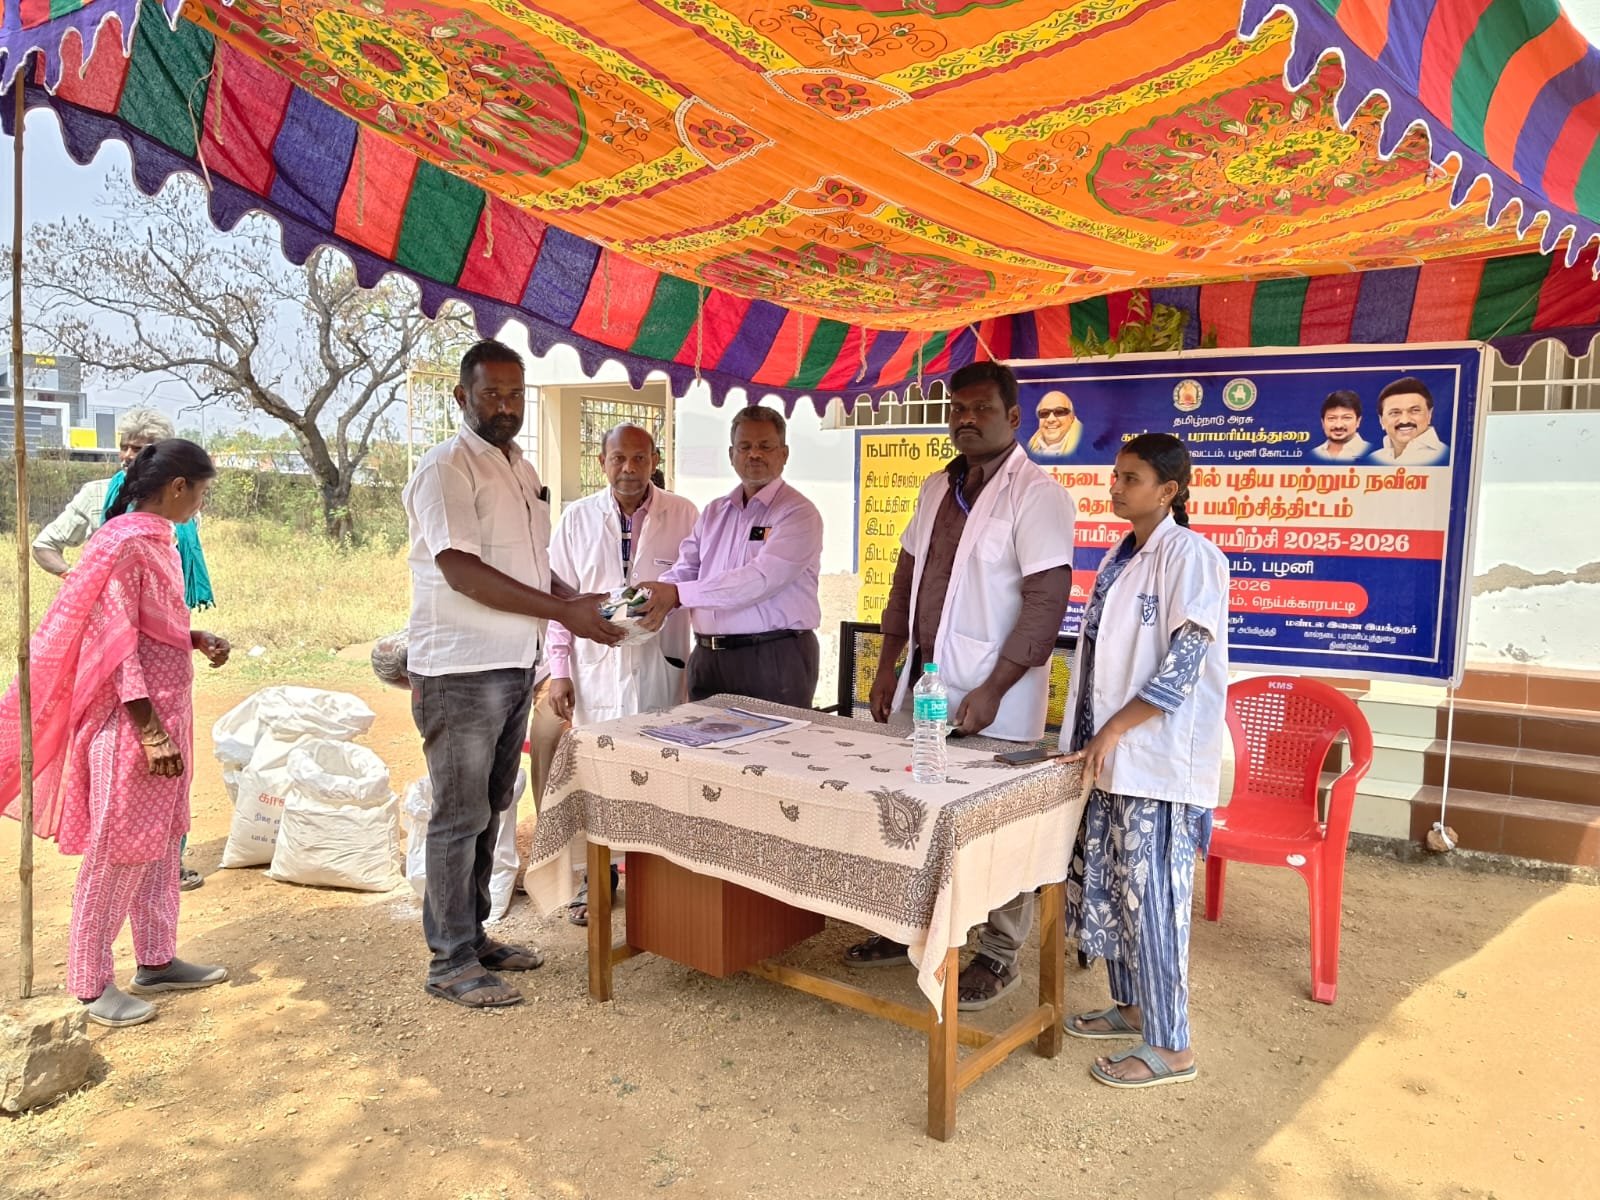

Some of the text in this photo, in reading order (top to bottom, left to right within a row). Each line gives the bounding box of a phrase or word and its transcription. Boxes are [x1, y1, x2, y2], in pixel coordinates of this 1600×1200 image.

[1173, 415, 1254, 427] தமிழ்நாடு அரசு
[1188, 428, 1310, 444] பராமரிப்புத்துறை
[866, 438, 920, 460] நபார்டு
[1228, 448, 1257, 461] பழனி
[1259, 448, 1303, 459] கோட்டம்
[1226, 468, 1274, 492] புதிய
[1279, 467, 1360, 493] மற்றும்
[1363, 467, 1429, 494] நவீன
[1203, 495, 1353, 520] பயிற்சித்திட்டம்
[1284, 531, 1410, 552] 2025-2026
[1262, 560, 1314, 577] பழனி
[1229, 579, 1271, 592] 2026
[1268, 681, 1294, 690] KMS
